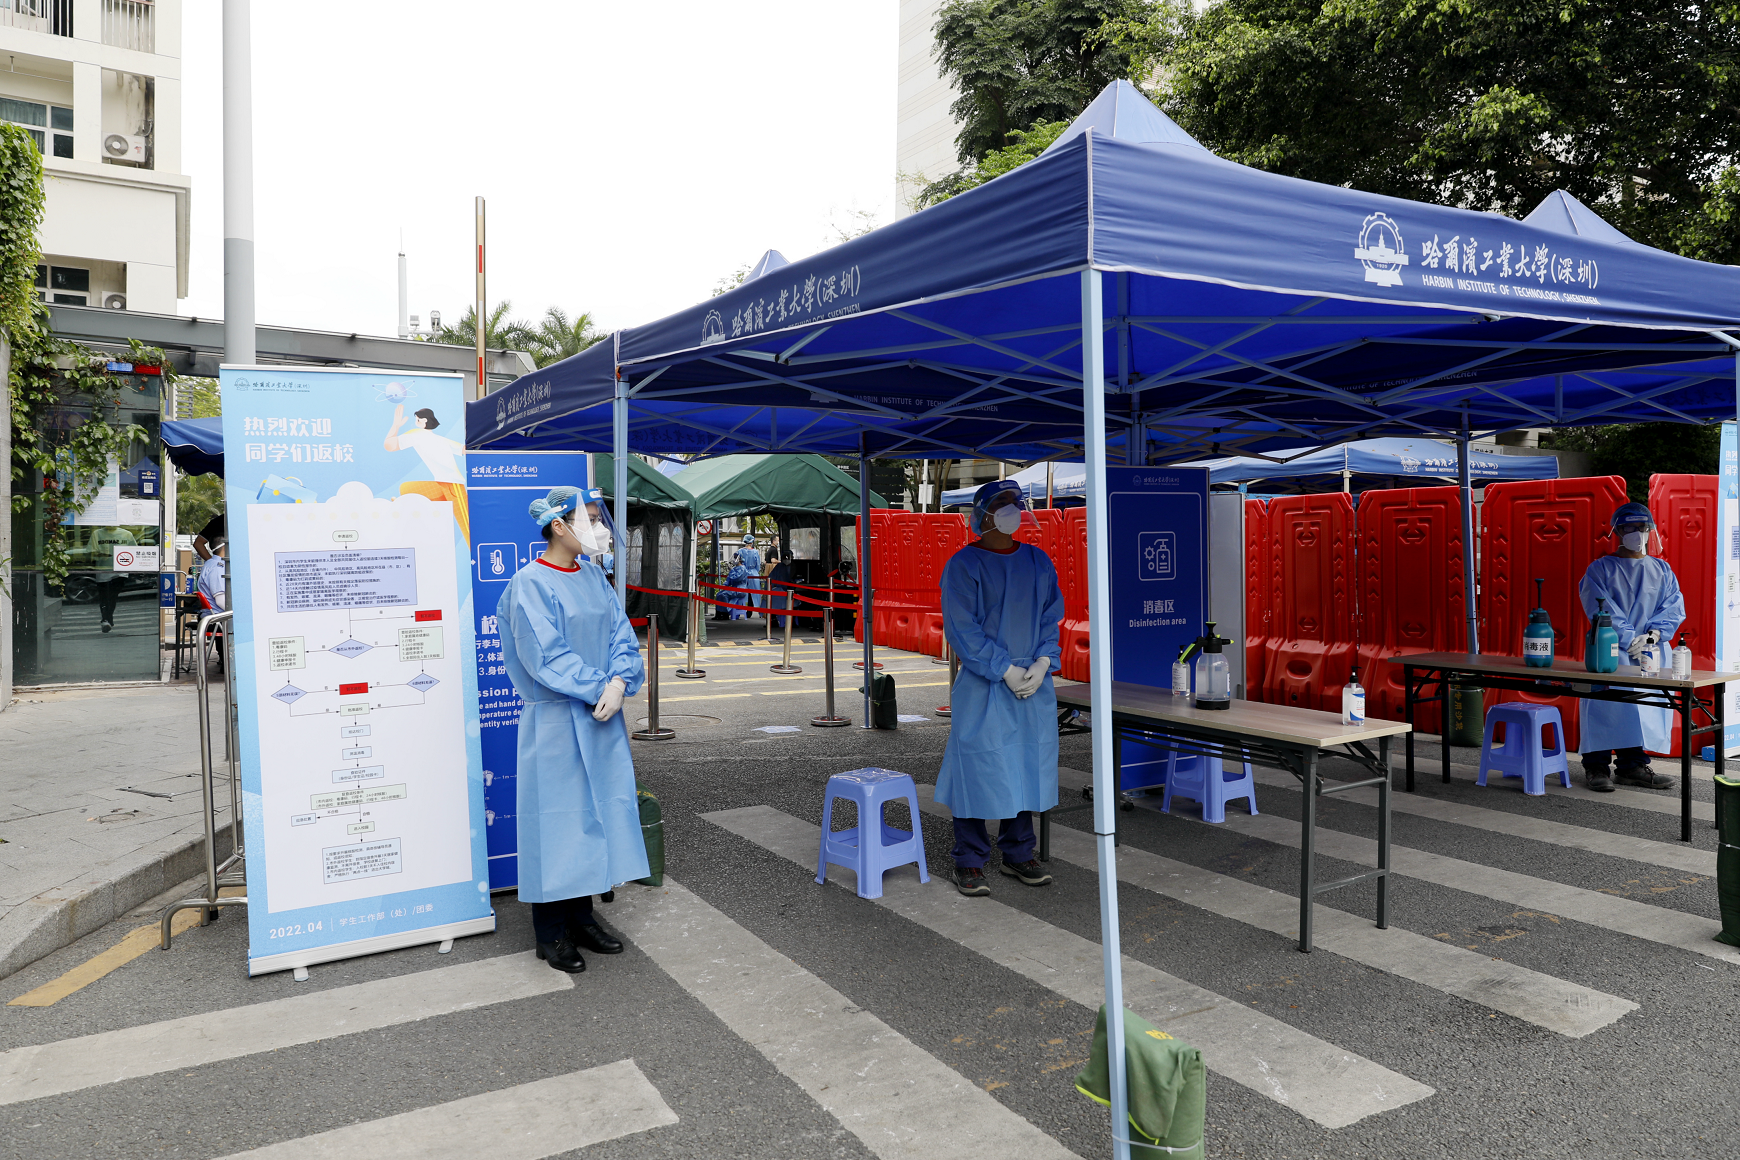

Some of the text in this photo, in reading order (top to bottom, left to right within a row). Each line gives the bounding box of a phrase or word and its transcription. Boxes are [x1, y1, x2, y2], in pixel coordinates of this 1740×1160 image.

[1422, 274, 1601, 305] HARBIN INSTITUTE OF TECHNOLOGY, SHENZHEN
[882, 397, 912, 405] INSTITUTE
[244, 417, 332, 437] 热烈欢迎
[245, 443, 354, 462] 同学们返校
[1143, 600, 1174, 614] 消毒区
[1129, 618, 1170, 628] Disinfection
[269, 920, 323, 939] 2022.04
